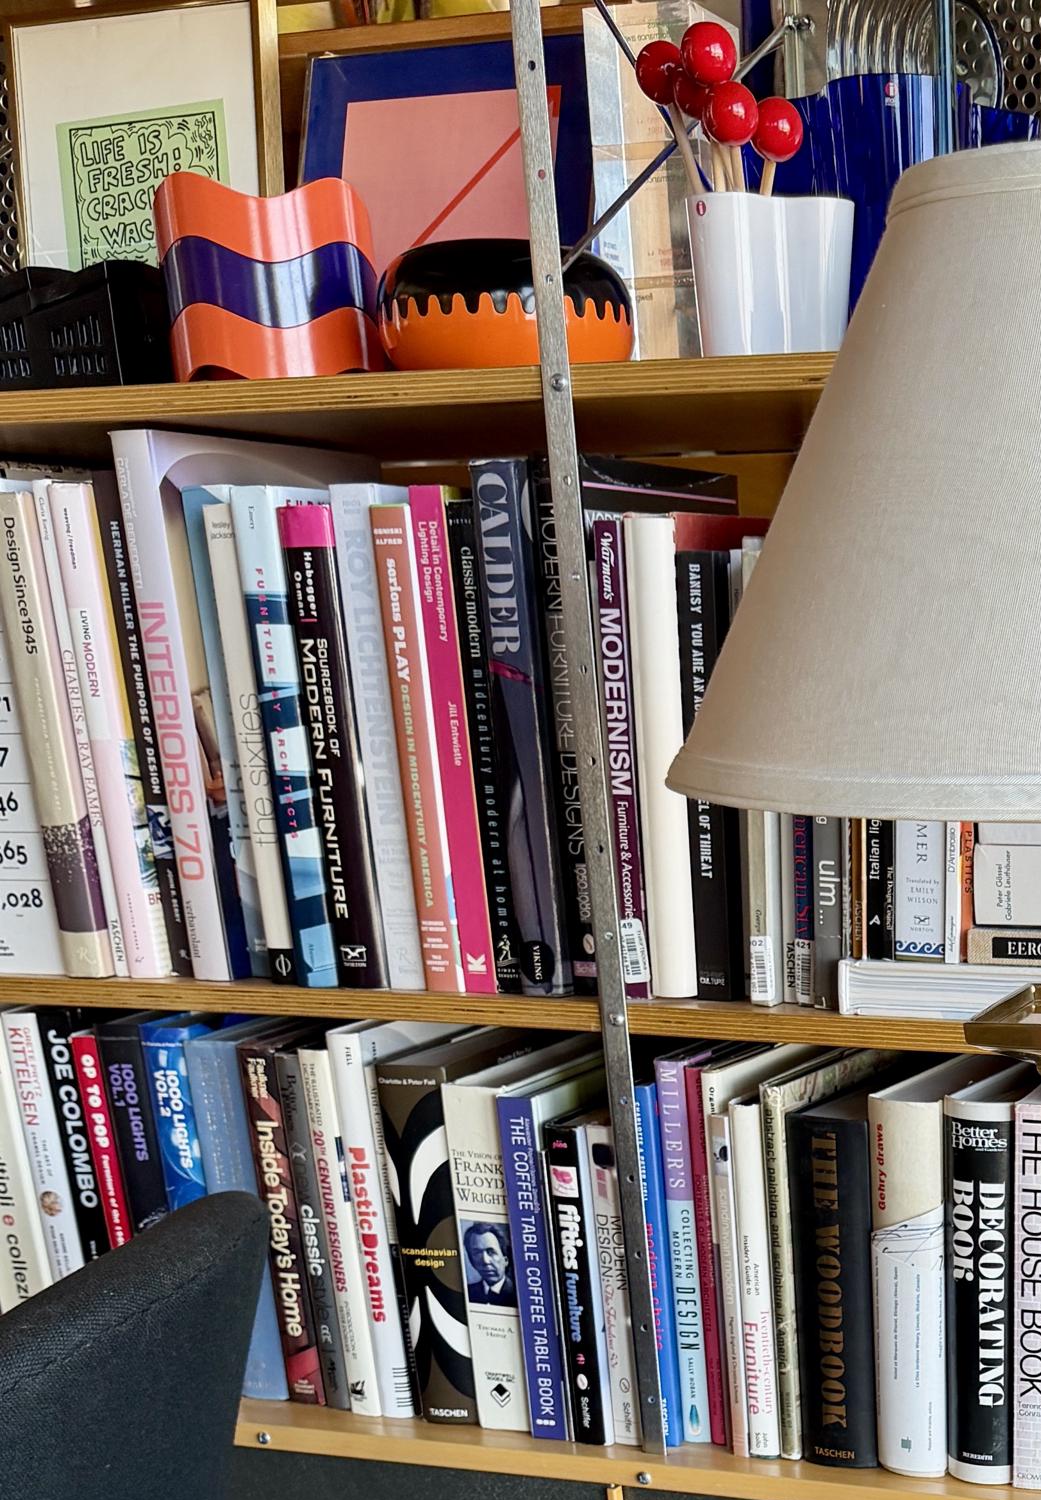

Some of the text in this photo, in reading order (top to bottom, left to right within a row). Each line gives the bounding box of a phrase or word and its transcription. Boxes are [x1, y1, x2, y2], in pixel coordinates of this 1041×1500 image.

[80, 129, 162, 167] LIFE IS
[88, 147, 181, 193] FRESH!
[4, 517, 38, 655] Design Since 1945
[477, 472, 521, 656] CALDER
[603, 531, 615, 603] Warman's
[80, 610, 100, 698] LIVING MODERN
[110, 521, 161, 795] HERMAN MILLER THE PURPOSE OF DESIGN
[689, 563, 705, 693] BANKSY YOU ARE AN
[140, 601, 205, 881] INTERIORS '70
[239, 694, 272, 787] sixties
[300, 639, 349, 919] MODERN FURNITURE
[254, 796, 279, 847] the
[868, 838, 880, 880] Italian
[910, 887, 935, 895] EMILY
[964, 830, 973, 894] PLASTICS
[907, 897, 938, 905] WILSON
[532, 944, 543, 981] VIKING
[786, 942, 795, 988] TASCHEN
[8, 1027, 40, 1126] KITTELSEN
[47, 1029, 74, 1080] JOE
[81, 1054, 110, 1149] OP TO POP
[121, 1064, 149, 1161] 1000 LIGHTS
[165, 1070, 194, 1169] 1000 LIGHTS
[510, 1116, 526, 1146] THE
[660, 1068, 686, 1188] MILLER'S
[952, 1121, 998, 1139] Better
[59, 1084, 98, 1208] COLOMBO
[453, 1157, 504, 1175] FRANK
[876, 1123, 887, 1210] Gehry draws
[952, 1135, 1008, 1149] Homes
[456, 1172, 505, 1189] LLOYD
[456, 1187, 508, 1207] WRIGHT
[513, 1152, 534, 1211] COFFEE
[256, 1120, 303, 1337] Inside Today's Home
[301, 1204, 325, 1277] classic
[401, 1247, 458, 1257] scandinavian
[521, 1216, 539, 1261] TABLE
[610, 1215, 628, 1291] MODERN
[672, 1231, 682, 1280] MODERN
[681, 1209, 694, 1280] COLLECTING
[953, 1179, 974, 1281] BOOK
[415, 1258, 445, 1268] design
[526, 1267, 546, 1323] COFFEE
[812, 1132, 847, 1428] THE WOODBOOK
[978, 1181, 1006, 1408] DECORATING
[533, 1328, 551, 1373] TABLE
[676, 1286, 700, 1351] DESIGN
[538, 1377, 555, 1415] BOOK
[745, 1321, 761, 1416] Furniture
[428, 1408, 468, 1418] TASCHEN
[815, 1446, 855, 1459] TASCHEN
